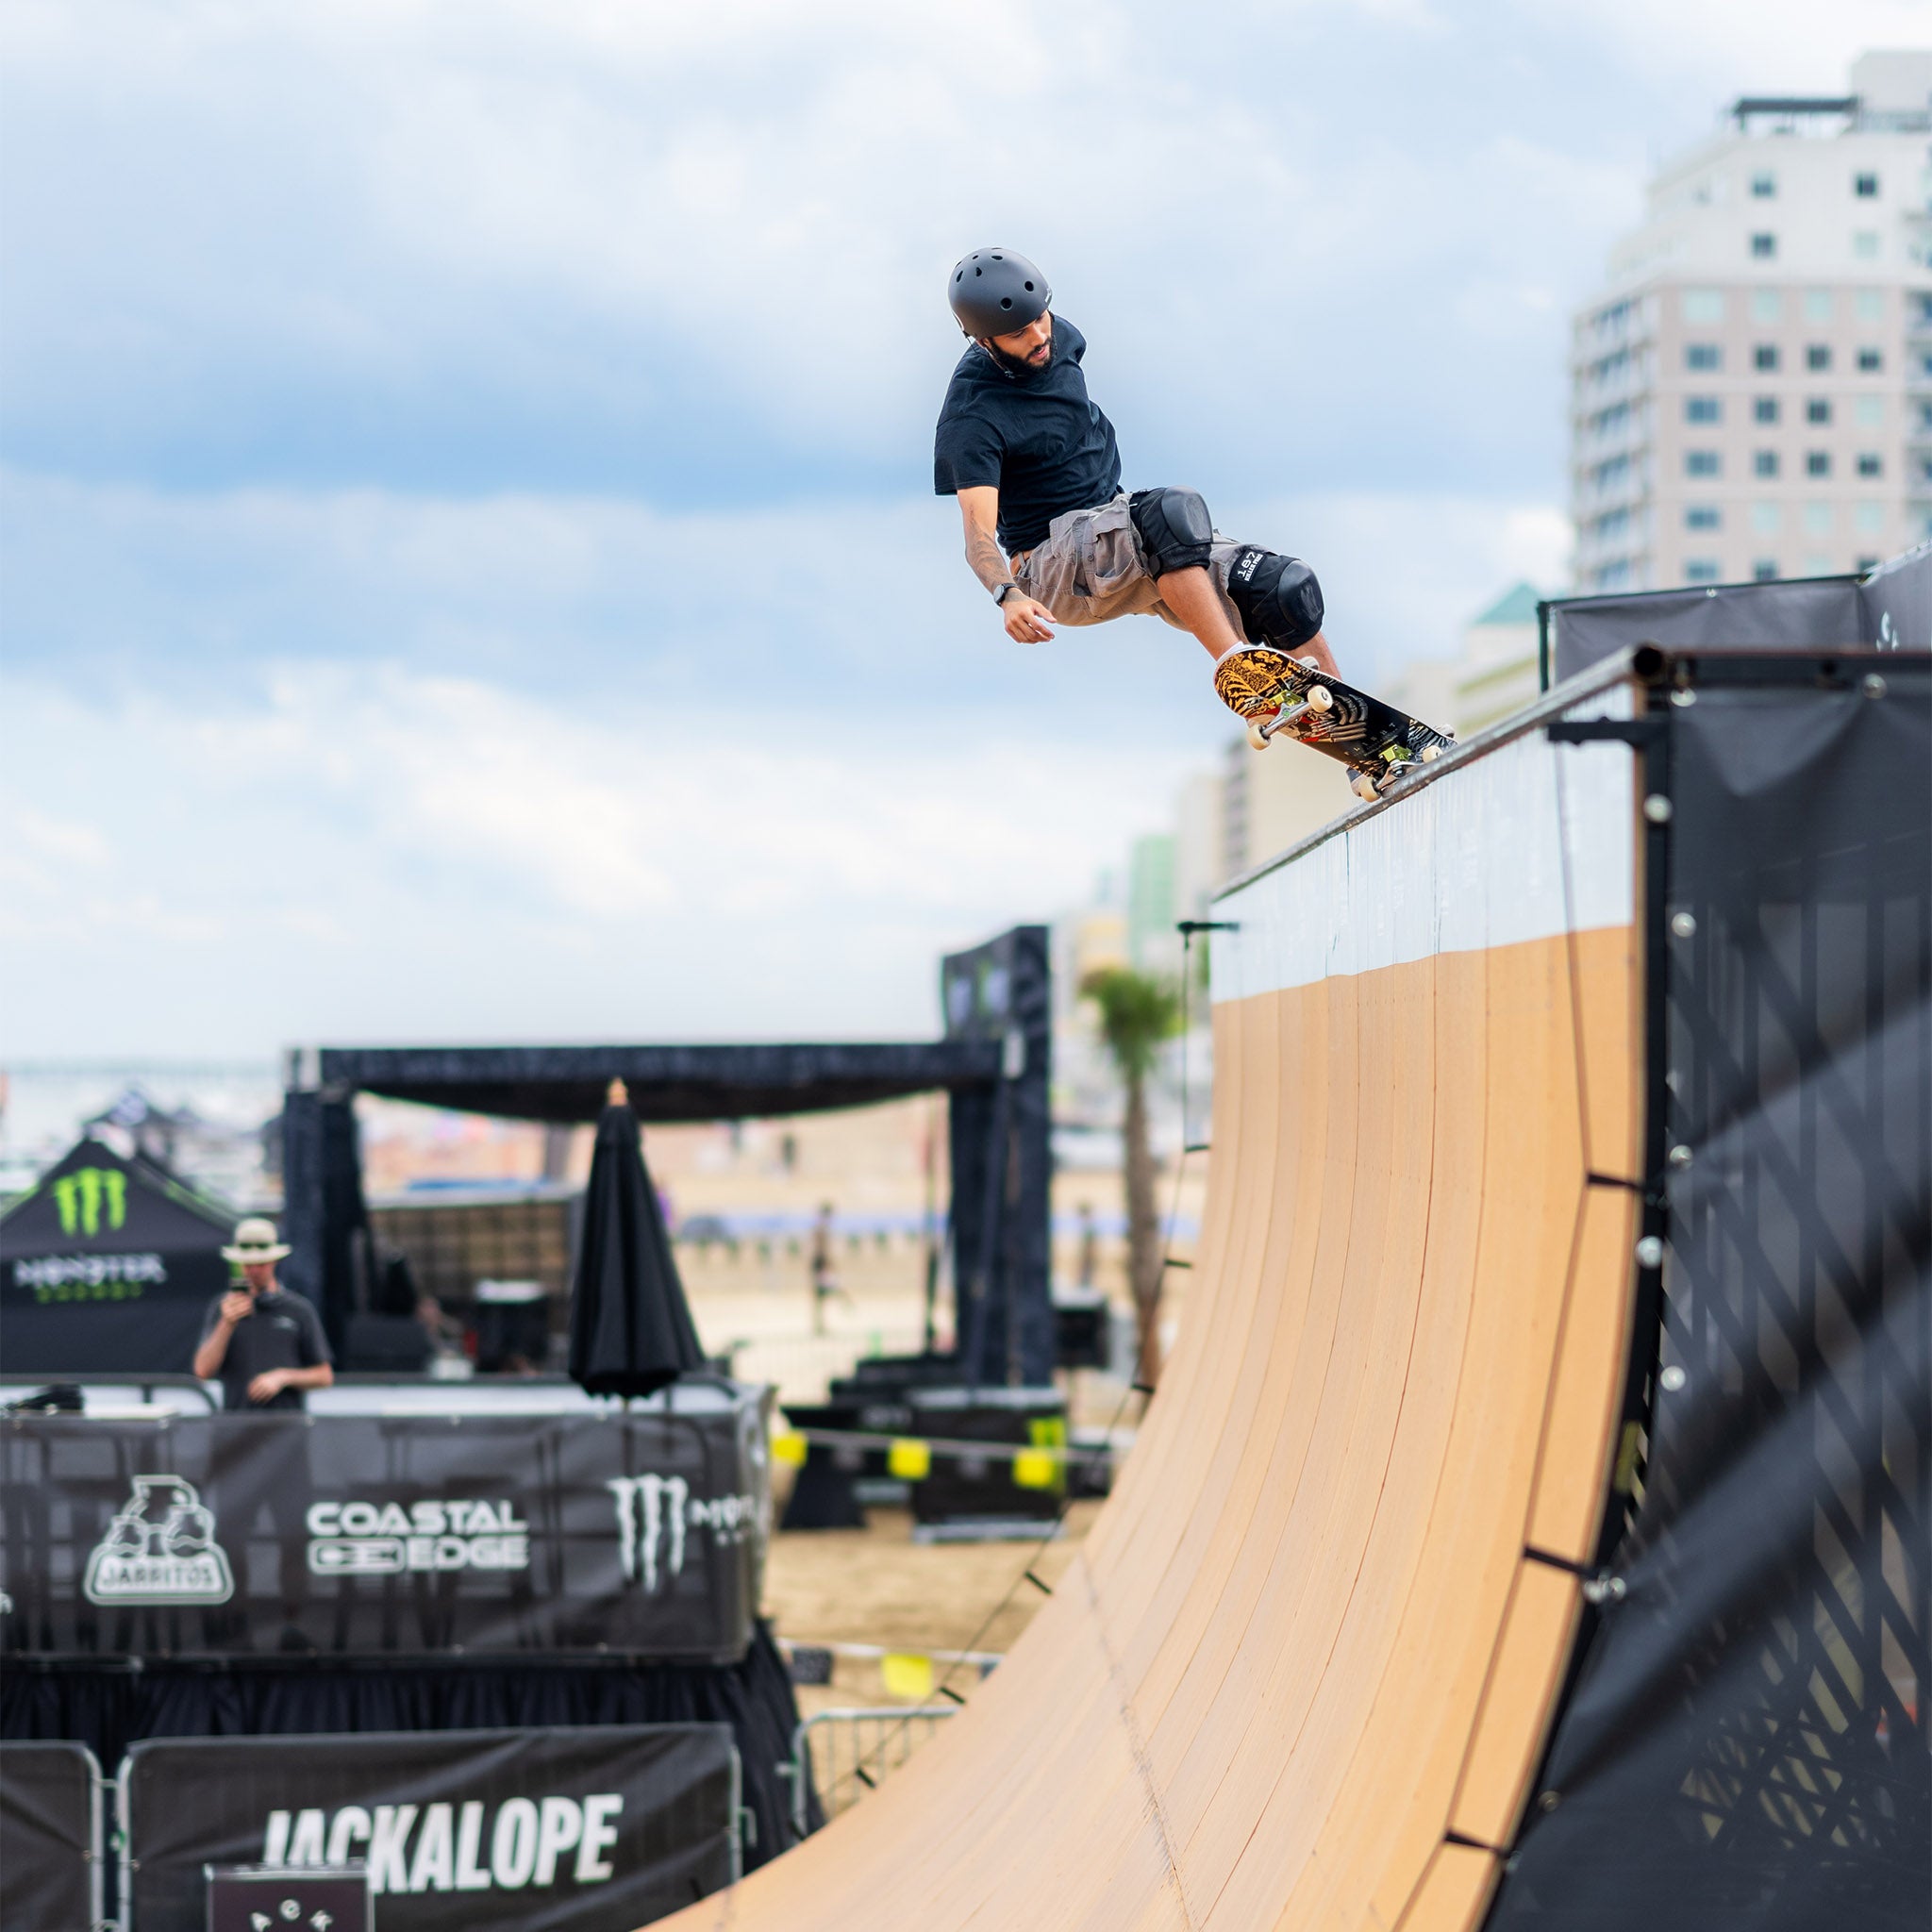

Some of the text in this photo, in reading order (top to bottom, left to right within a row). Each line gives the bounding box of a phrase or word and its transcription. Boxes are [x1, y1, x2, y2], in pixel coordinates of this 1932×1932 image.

[1237, 552, 1256, 578] 187
[308, 1501, 529, 1536] COASTAL
[406, 1535, 529, 1570] EDGE
